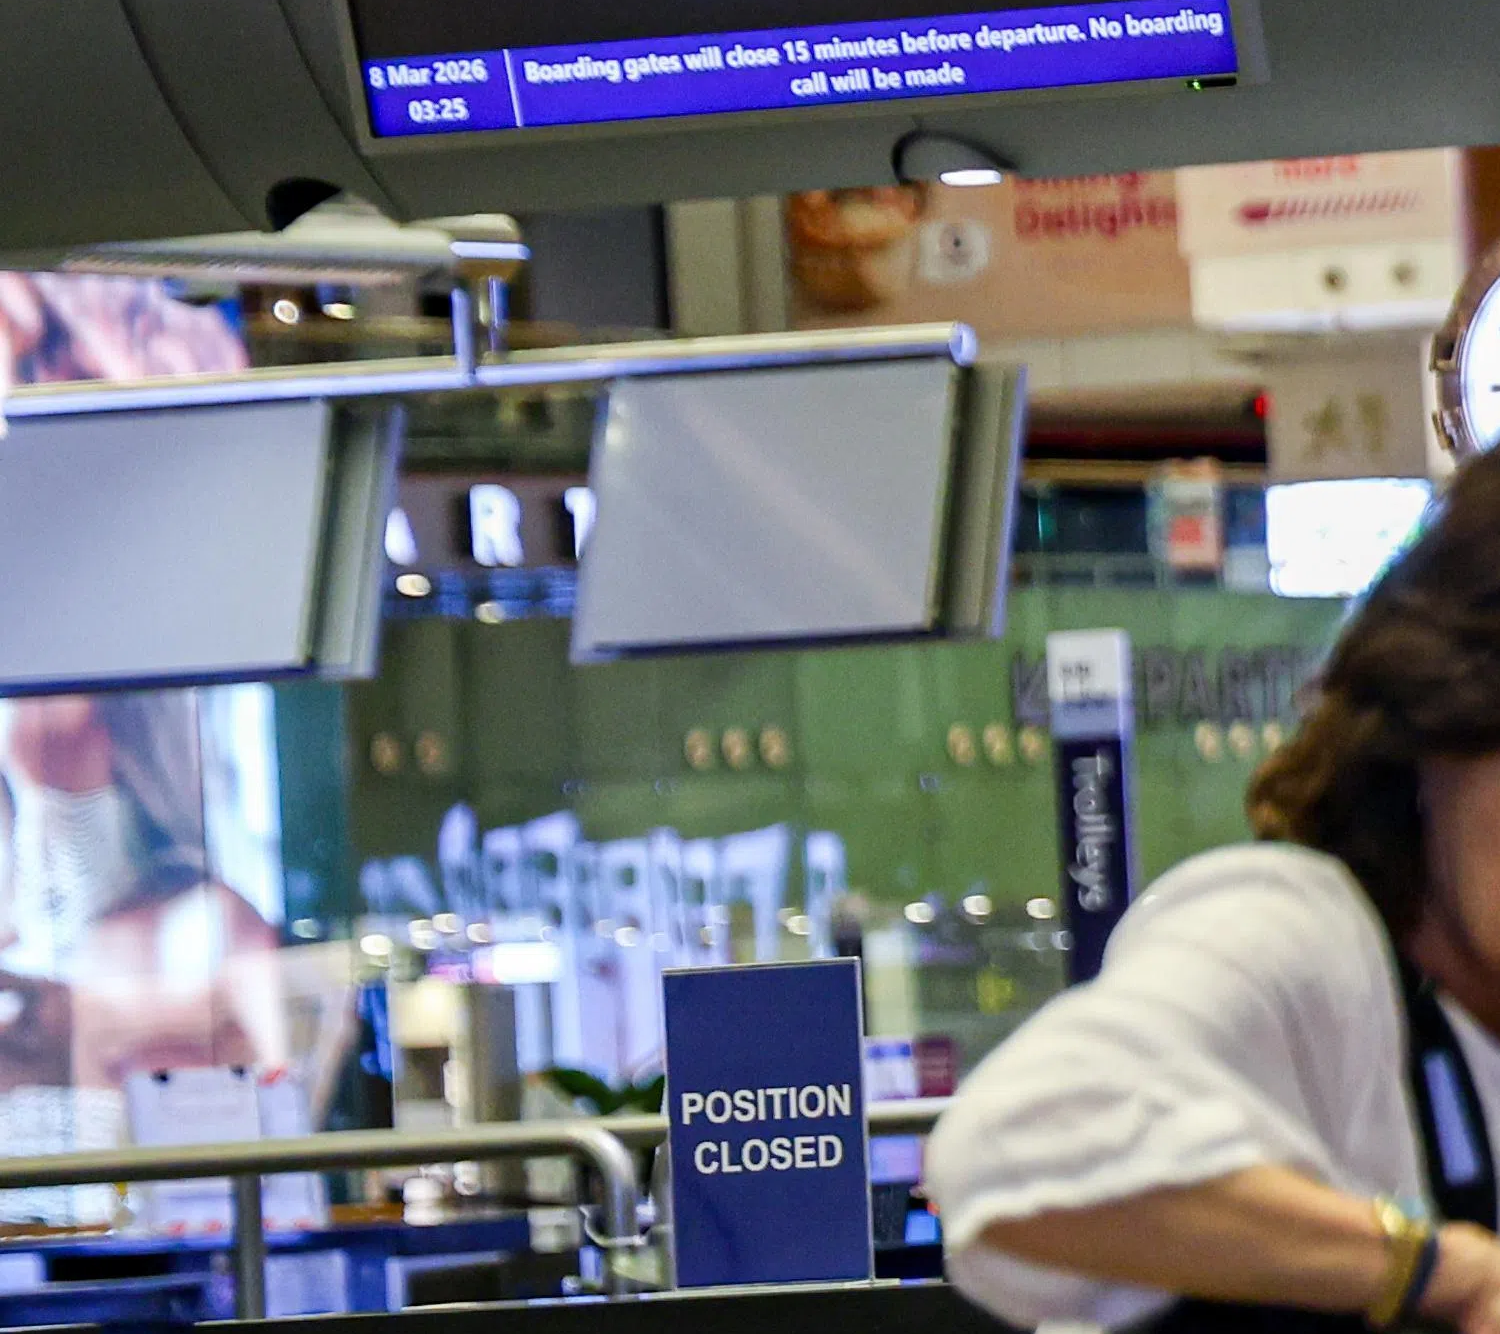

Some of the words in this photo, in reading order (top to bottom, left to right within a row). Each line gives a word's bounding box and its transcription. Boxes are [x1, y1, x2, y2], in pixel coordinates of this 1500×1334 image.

[522, 55, 623, 84] Boarding
[622, 52, 684, 82] gates
[681, 45, 725, 72] will
[724, 43, 781, 69] close
[781, 39, 811, 64] 15
[812, 35, 900, 61] minutes
[899, 28, 973, 54] before
[974, 22, 1087, 52] departure.
[1087, 16, 1123, 40] No
[1123, 8, 1224, 37] boarding
[367, 65, 387, 89] 8
[385, 63, 432, 86] Mar
[431, 57, 488, 84] 2026
[789, 70, 829, 97] call
[828, 67, 871, 93] will
[870, 66, 902, 90] be
[903, 60, 965, 87] made
[407, 96, 470, 123] 03:25
[1067, 749, 1116, 913] Trolleys
[681, 1083, 852, 1126] POSITION
[694, 1135, 843, 1175] CLOSED
